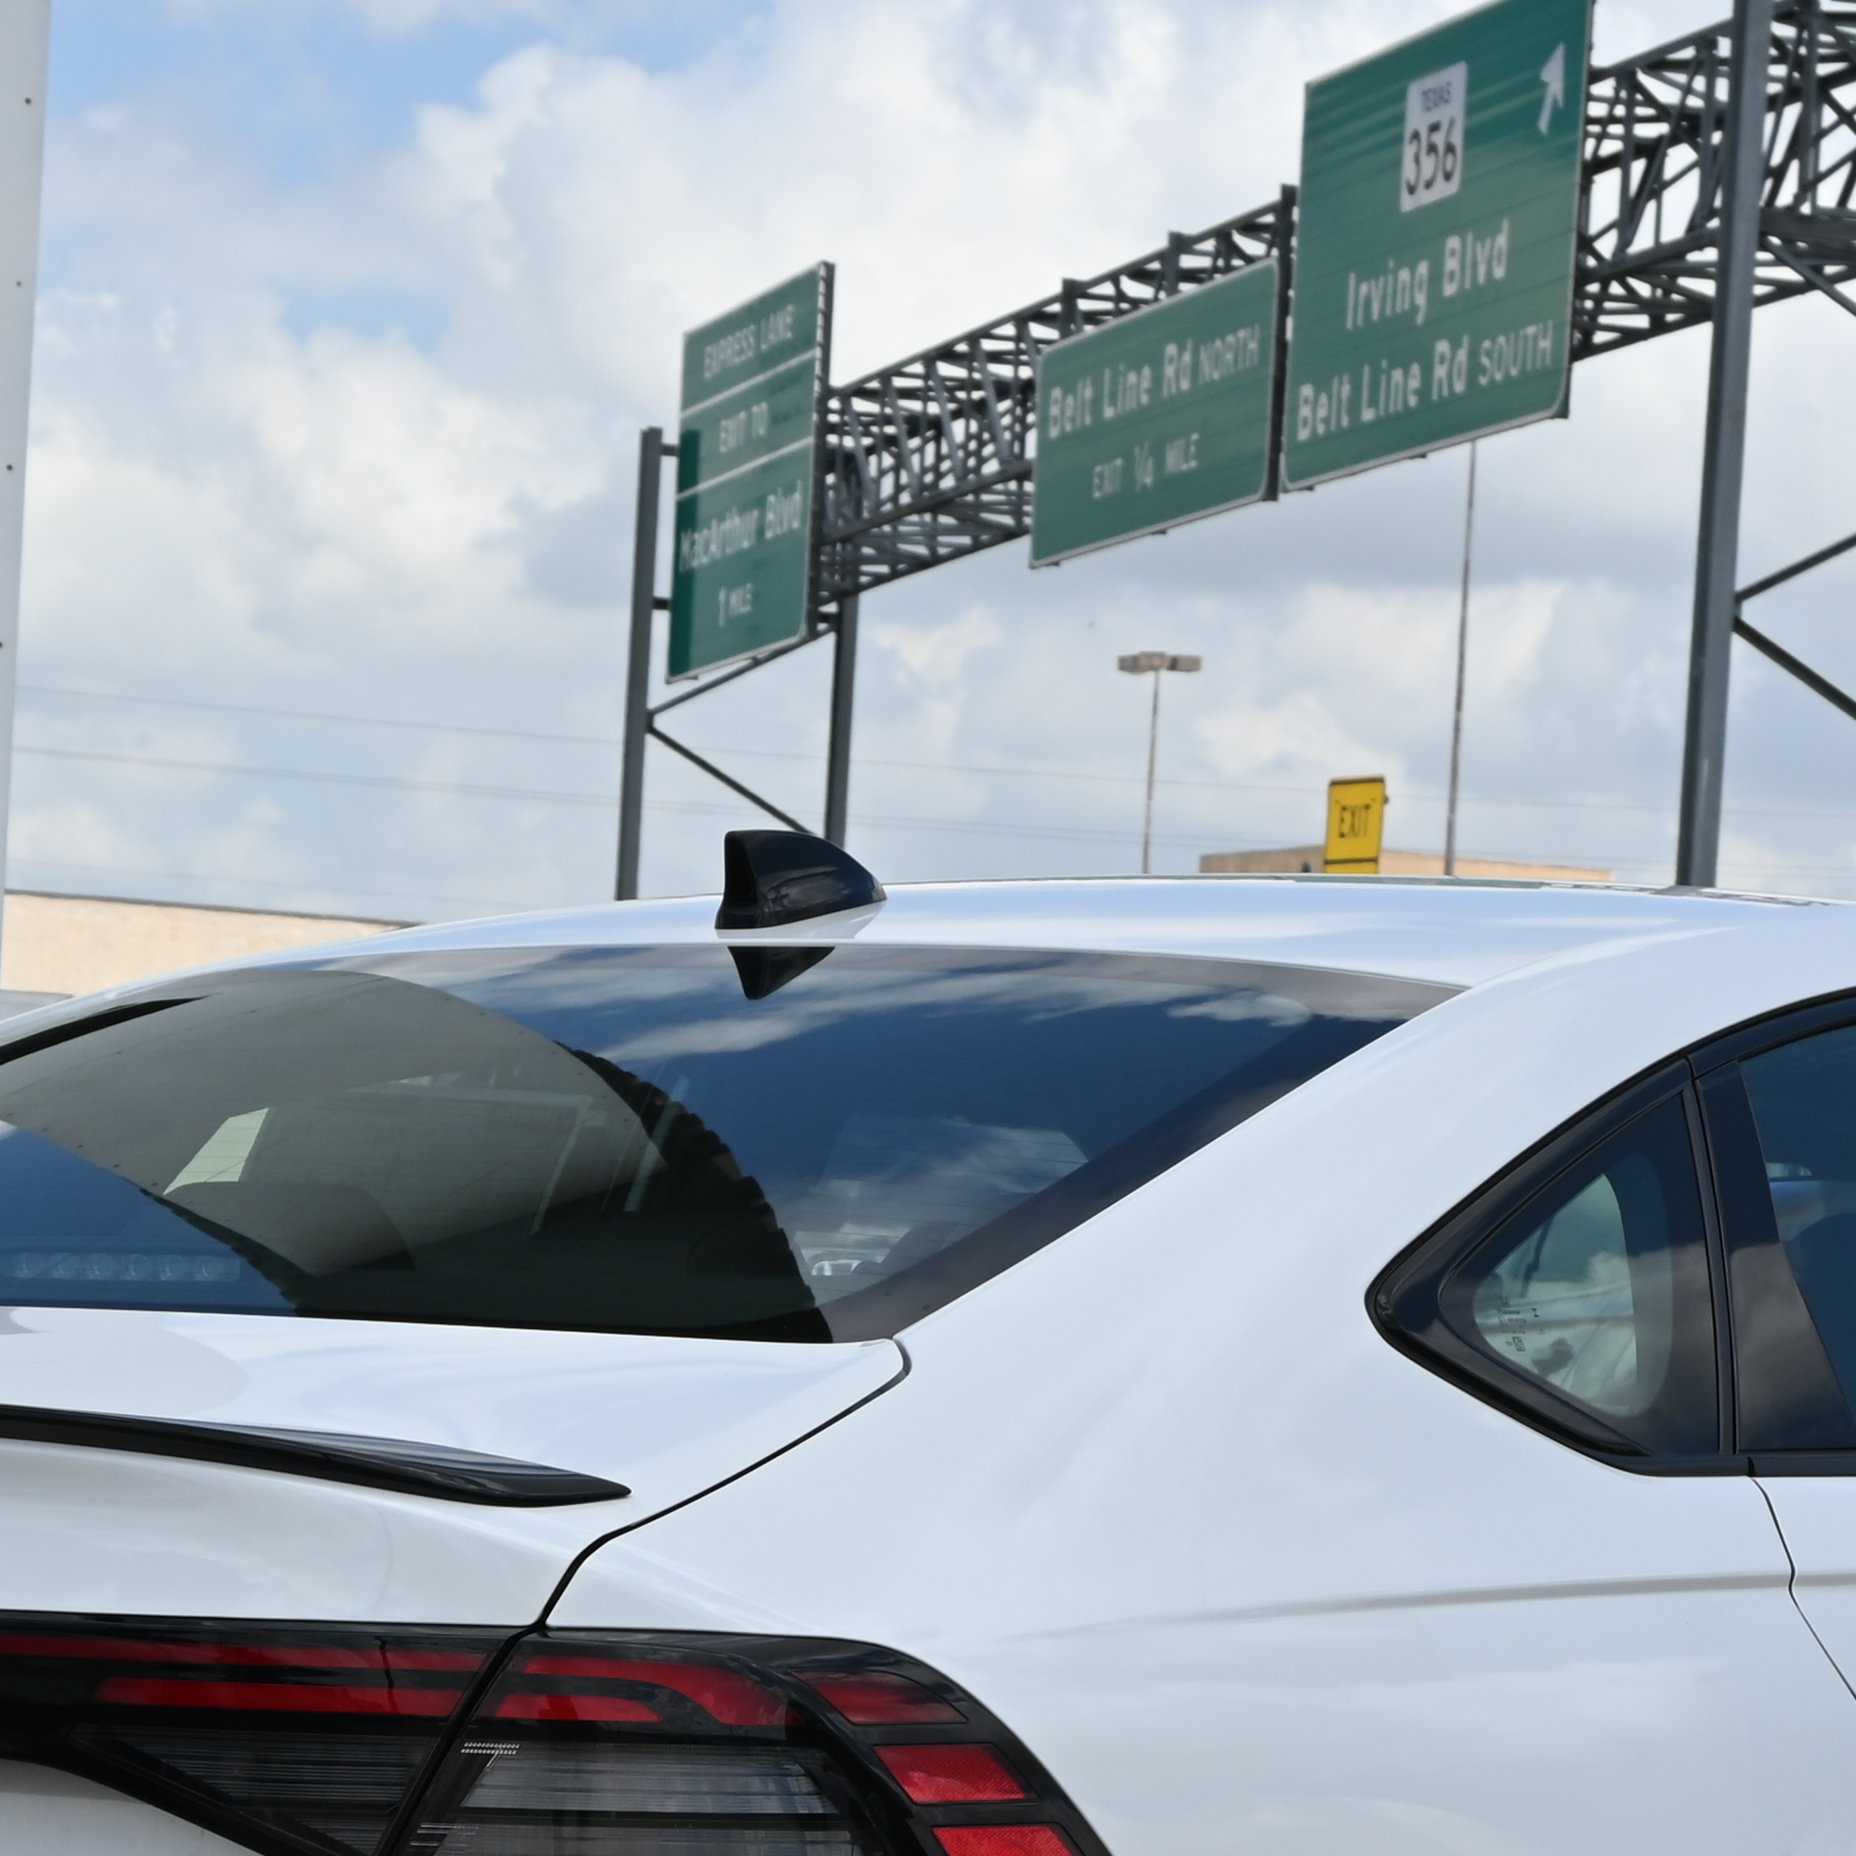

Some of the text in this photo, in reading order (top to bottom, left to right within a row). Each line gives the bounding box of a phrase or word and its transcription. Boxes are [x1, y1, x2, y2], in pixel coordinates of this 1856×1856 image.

[1405, 117, 1457, 195] 356
[1347, 218, 1509, 330] Irving Blvd
[1048, 324, 1261, 439] Belt Line Rd NORTH
[1297, 321, 1553, 441] Belt Line Rd SOUTH
[1338, 803, 1372, 839] EXIT
